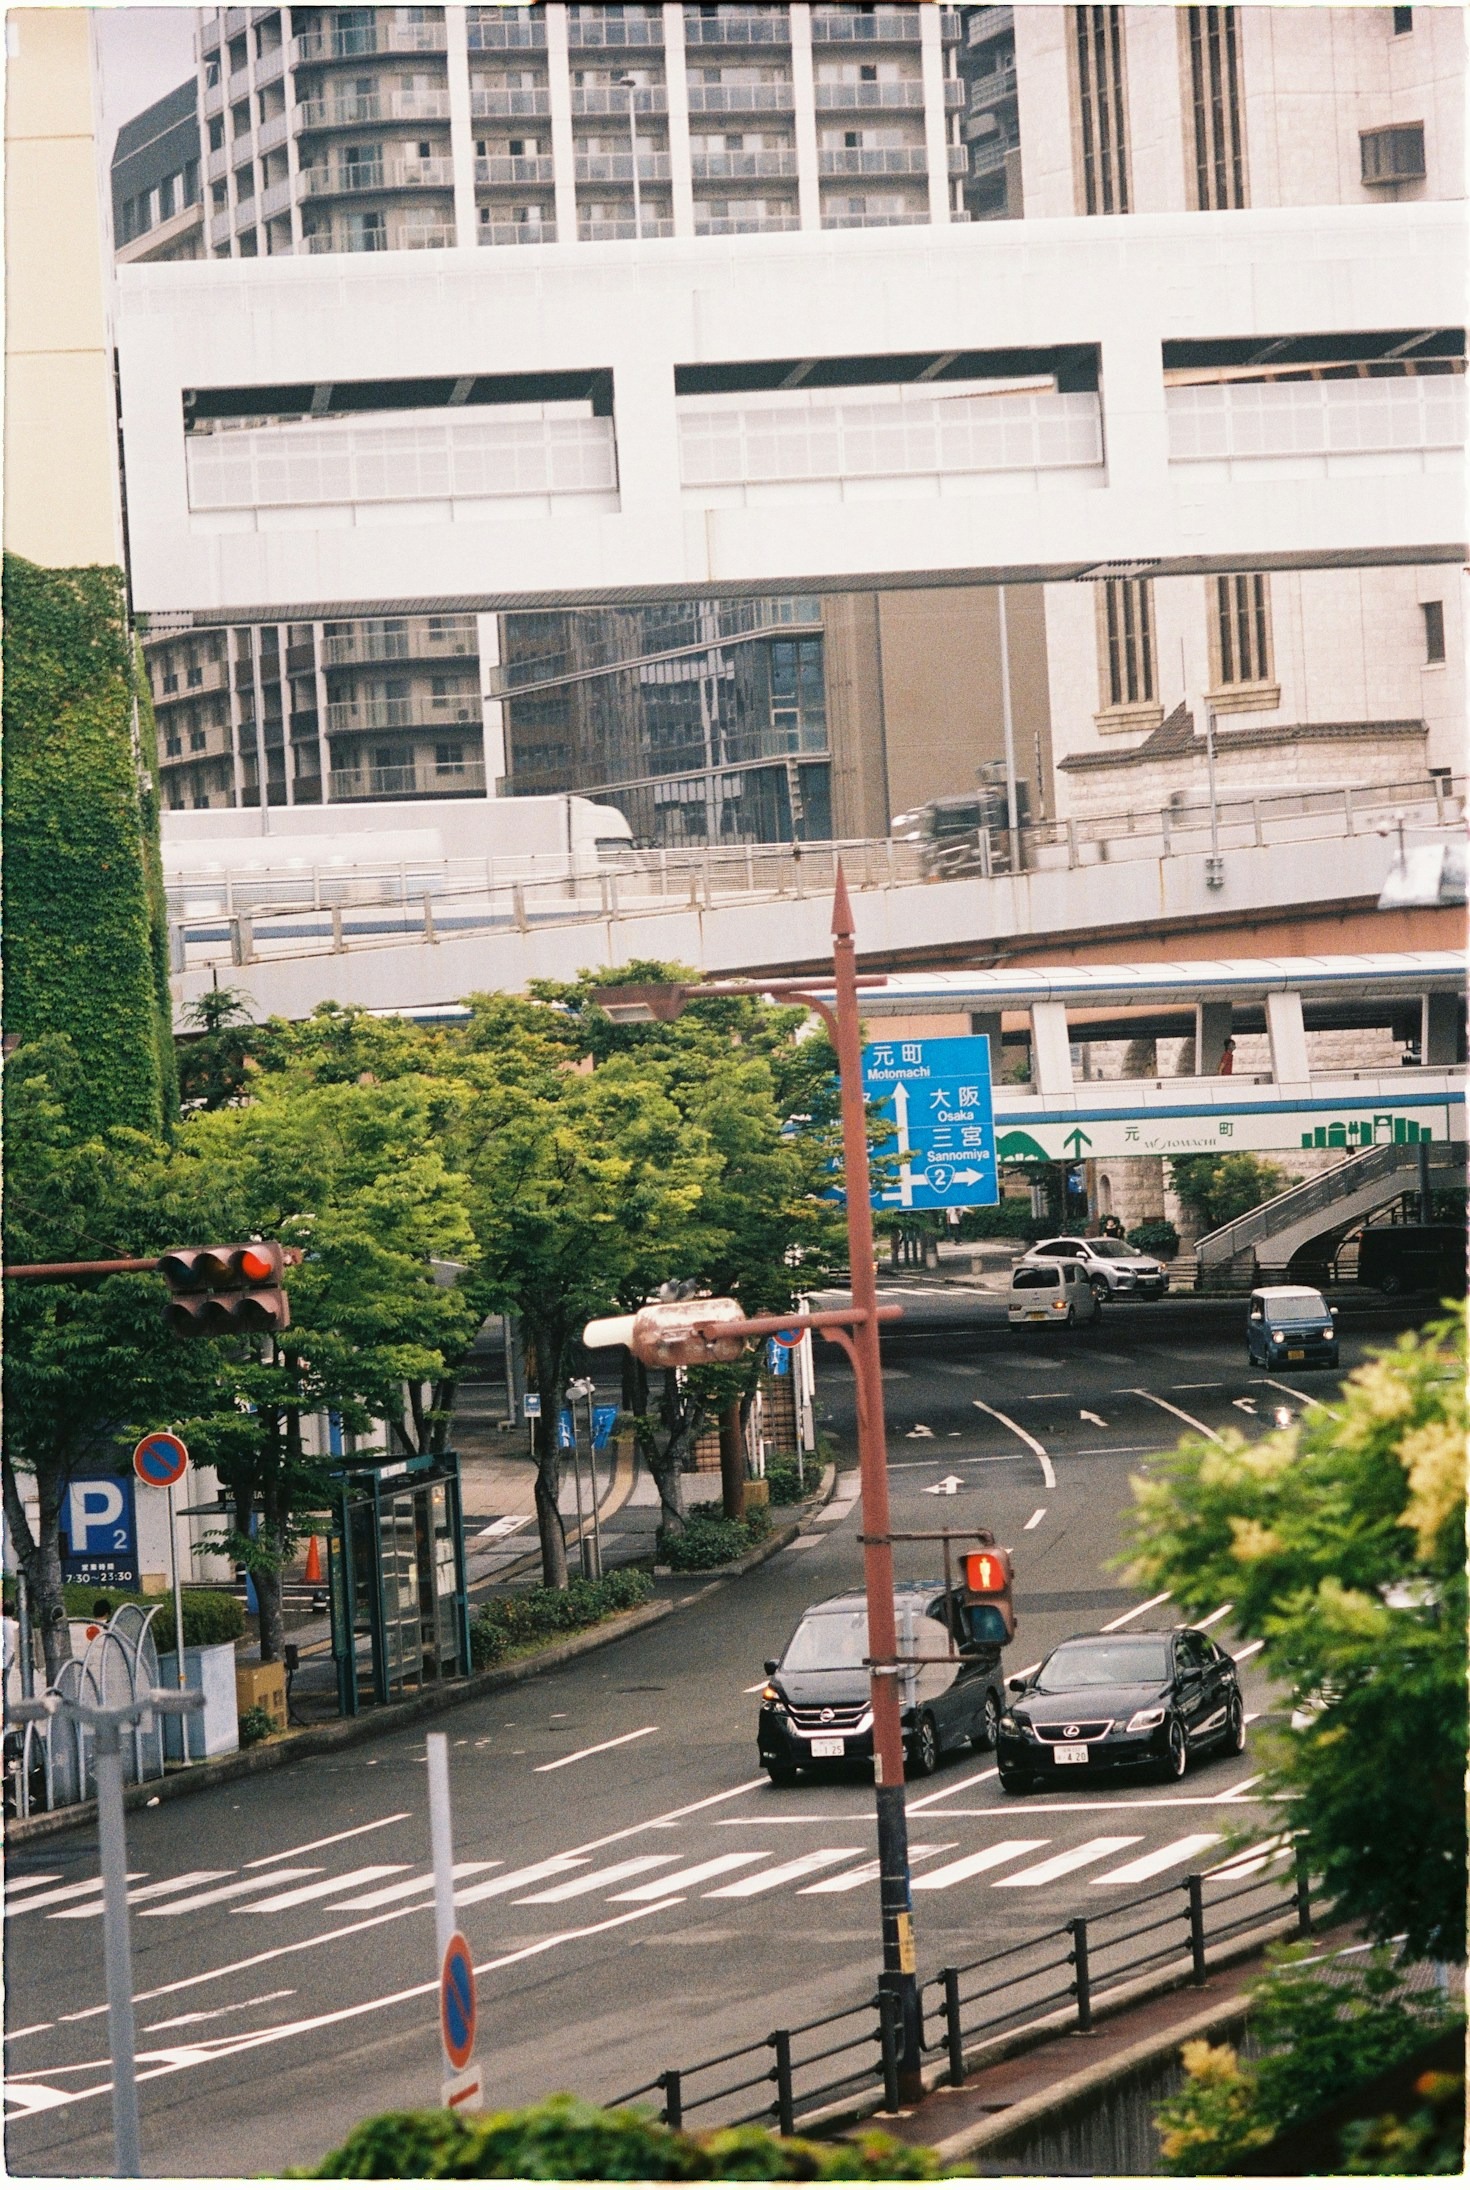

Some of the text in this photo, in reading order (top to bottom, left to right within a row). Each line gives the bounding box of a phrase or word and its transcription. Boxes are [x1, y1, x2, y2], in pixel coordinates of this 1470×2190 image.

[873, 1043, 922, 1067] 元町
[867, 1066, 931, 1080] Motomachi
[929, 1086, 981, 1110] 大阪
[937, 1110, 974, 1122] Osaka
[932, 1127, 982, 1148] 三宮
[927, 1149, 990, 1163] Sannomiya
[934, 1169, 946, 1186] 2
[69, 1481, 128, 1551] P 2
